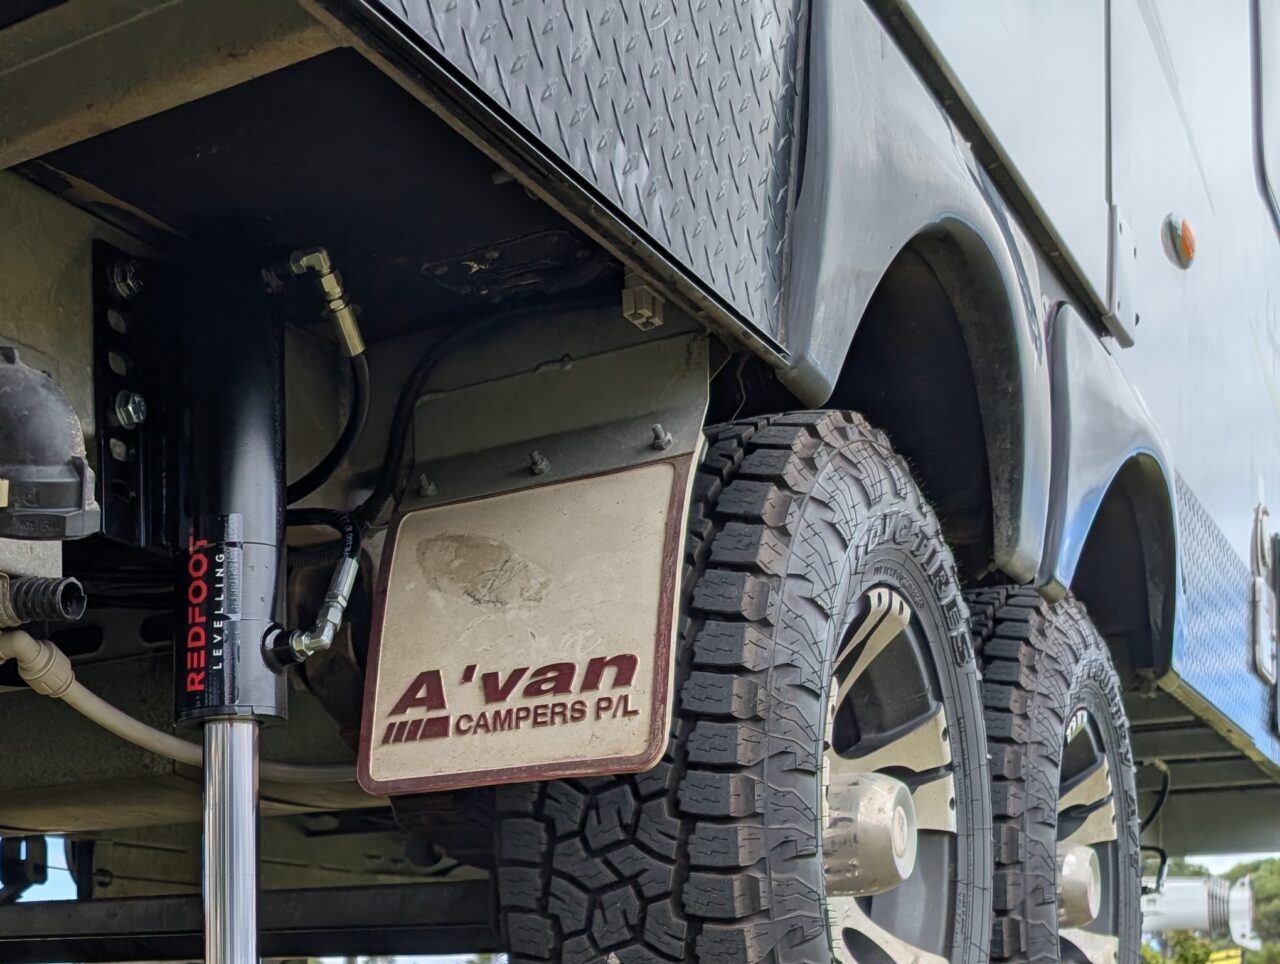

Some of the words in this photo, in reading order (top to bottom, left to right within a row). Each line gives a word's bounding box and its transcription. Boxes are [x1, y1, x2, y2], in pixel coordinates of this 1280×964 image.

[187, 527, 208, 692] REDFOOT
[212, 553, 225, 670] LEVELLING
[910, 524, 974, 668] TIRES
[388, 653, 640, 717] A'van
[455, 700, 588, 736] CAMPERS
[595, 694, 640, 721] P/L
